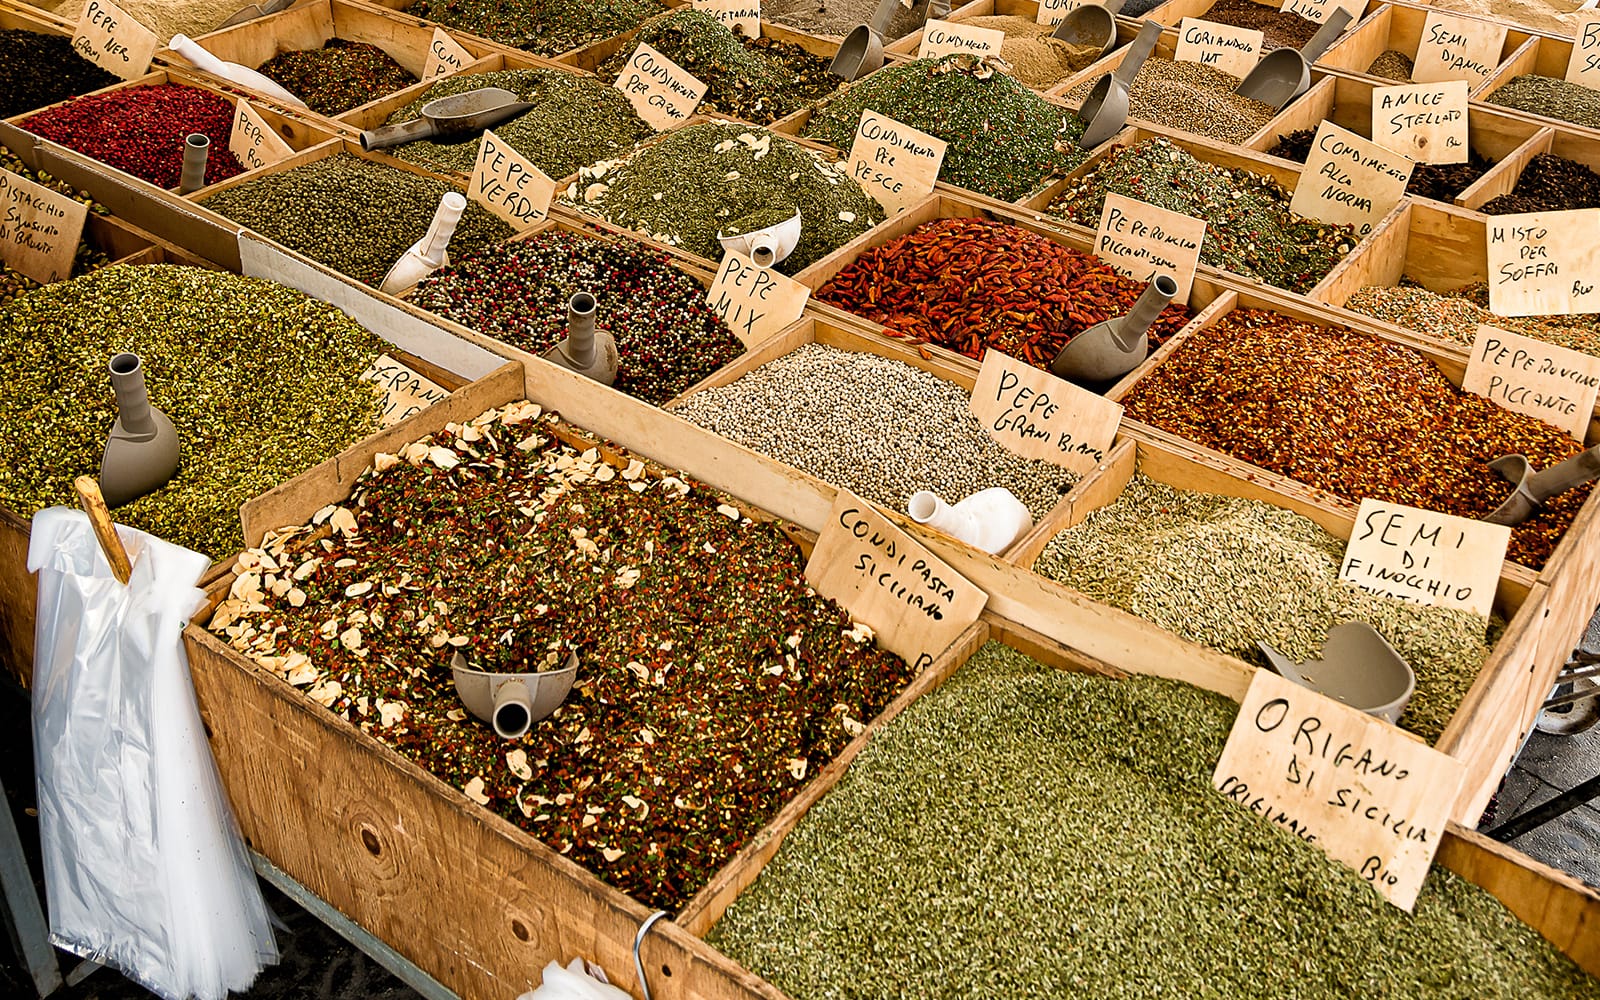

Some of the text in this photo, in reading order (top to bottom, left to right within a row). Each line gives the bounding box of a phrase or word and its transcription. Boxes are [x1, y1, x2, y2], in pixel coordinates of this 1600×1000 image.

[87, 1, 118, 33] PEPE
[1427, 24, 1467, 47] SEMI
[928, 29, 991, 50] CONDIMENTO
[1185, 27, 1253, 53] CORIANDOLO
[1200, 51, 1223, 64] INT
[634, 53, 697, 99] CONDIMENTO
[626, 74, 685, 119] PER CARNE
[1381, 93, 1444, 109] ANICE
[238, 111, 265, 146] PEPE
[861, 118, 935, 158] CONDIMENTO
[1389, 111, 1461, 135] STELLATO
[247, 147, 265, 169] RO
[483, 140, 533, 190] PEPE
[855, 160, 903, 193] PESCE
[875, 147, 896, 167] PER
[1320, 134, 1407, 182] CONDIMENTO
[480, 171, 544, 223] VERDE
[1321, 185, 1372, 213] NORMA
[1107, 207, 1197, 249] PEPERONCINO
[1492, 226, 1548, 243] MISTO
[1520, 246, 1548, 259] PER
[721, 258, 777, 300] PEPE
[1498, 262, 1558, 285] SOFFRI
[713, 291, 766, 335] MIX
[1481, 338, 1599, 388] PEPERONCINO
[996, 369, 1060, 419] PEPE
[1488, 375, 1577, 415] PICCANTE
[993, 408, 1051, 442] GRANI
[1359, 510, 1465, 549] SEMI
[1402, 550, 1430, 569] DI
[855, 554, 944, 621] SICILIANO
[911, 559, 955, 603] PASTA
[1345, 558, 1472, 601] FINOCCHIO
[1256, 698, 1409, 780] ORIGANO
[1286, 754, 1427, 843] DI SICILIA
